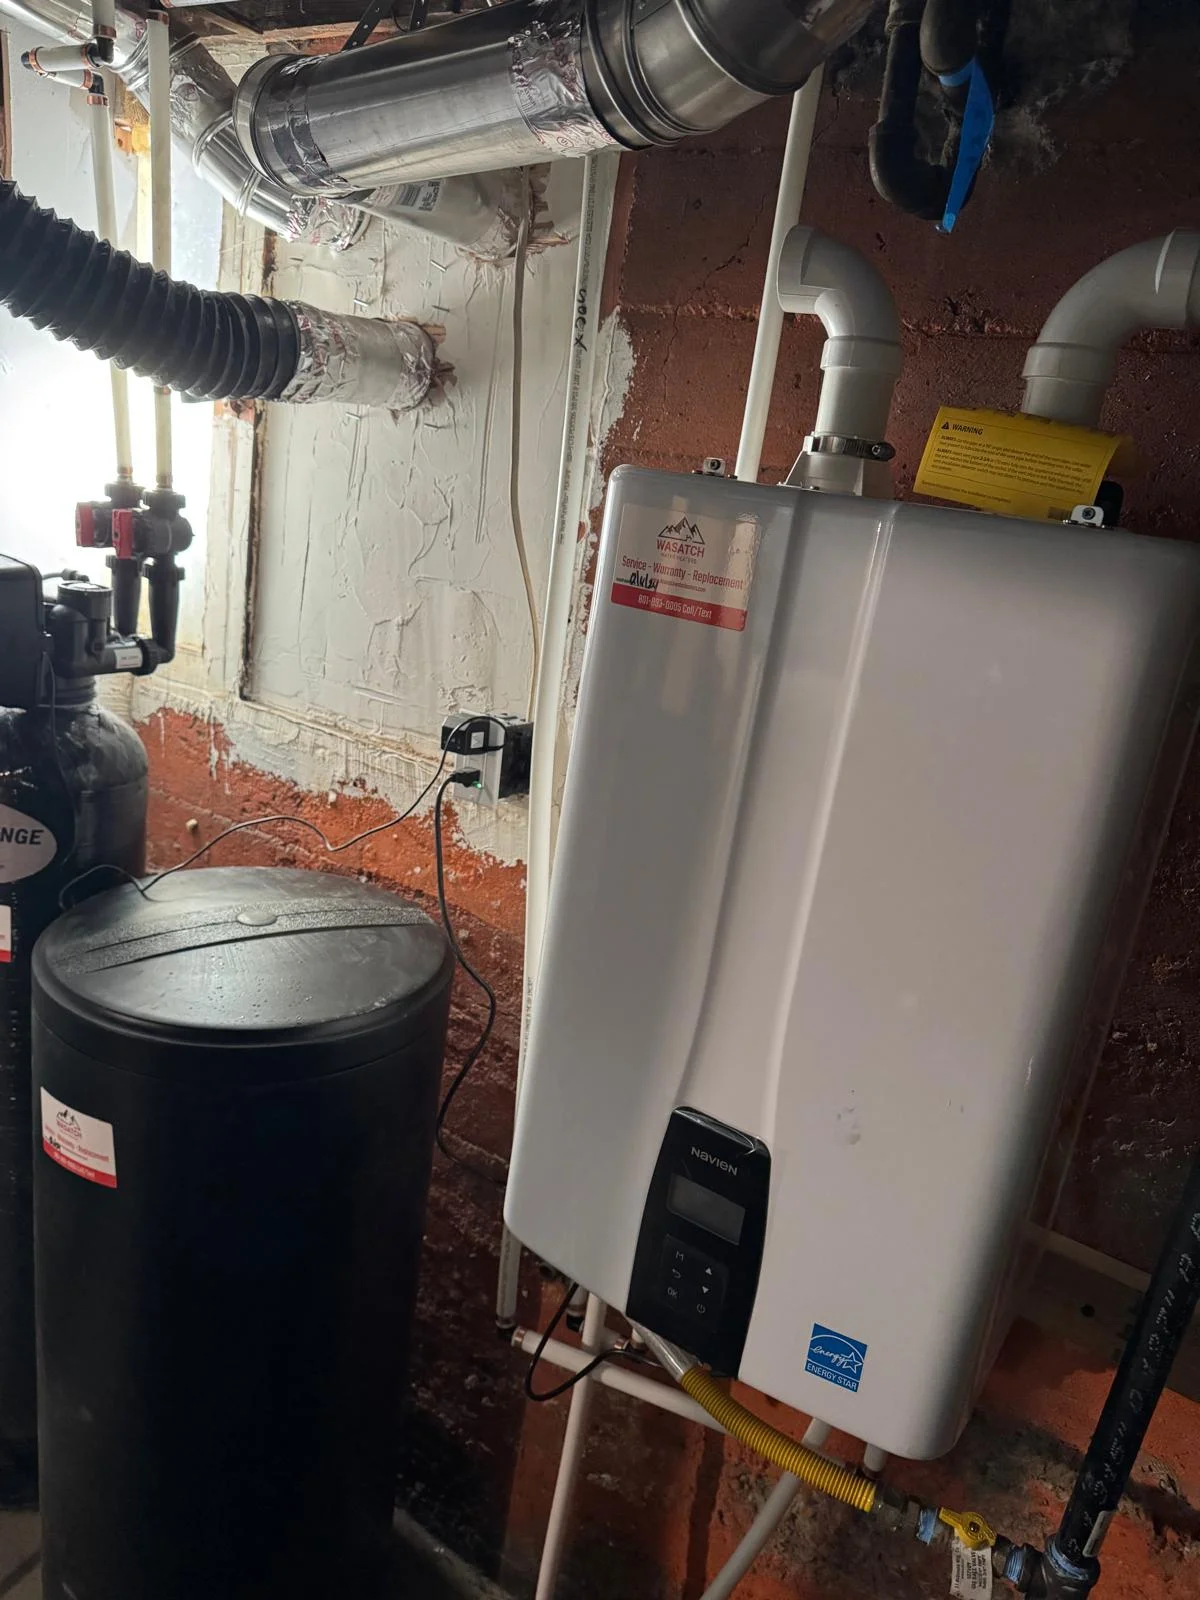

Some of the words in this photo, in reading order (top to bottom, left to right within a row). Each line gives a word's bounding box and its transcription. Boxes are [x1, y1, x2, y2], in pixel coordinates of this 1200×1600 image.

[951, 423, 984, 436] WARNING
[656, 539, 706, 559] WASATCH
[622, 555, 647, 571] Service
[653, 561, 687, 581] Warranty
[693, 569, 744, 591] Replacement
[675, 1250, 685, 1262] M
[806, 1362, 837, 1381] ENERGY
[836, 1375, 857, 1391] STAR
